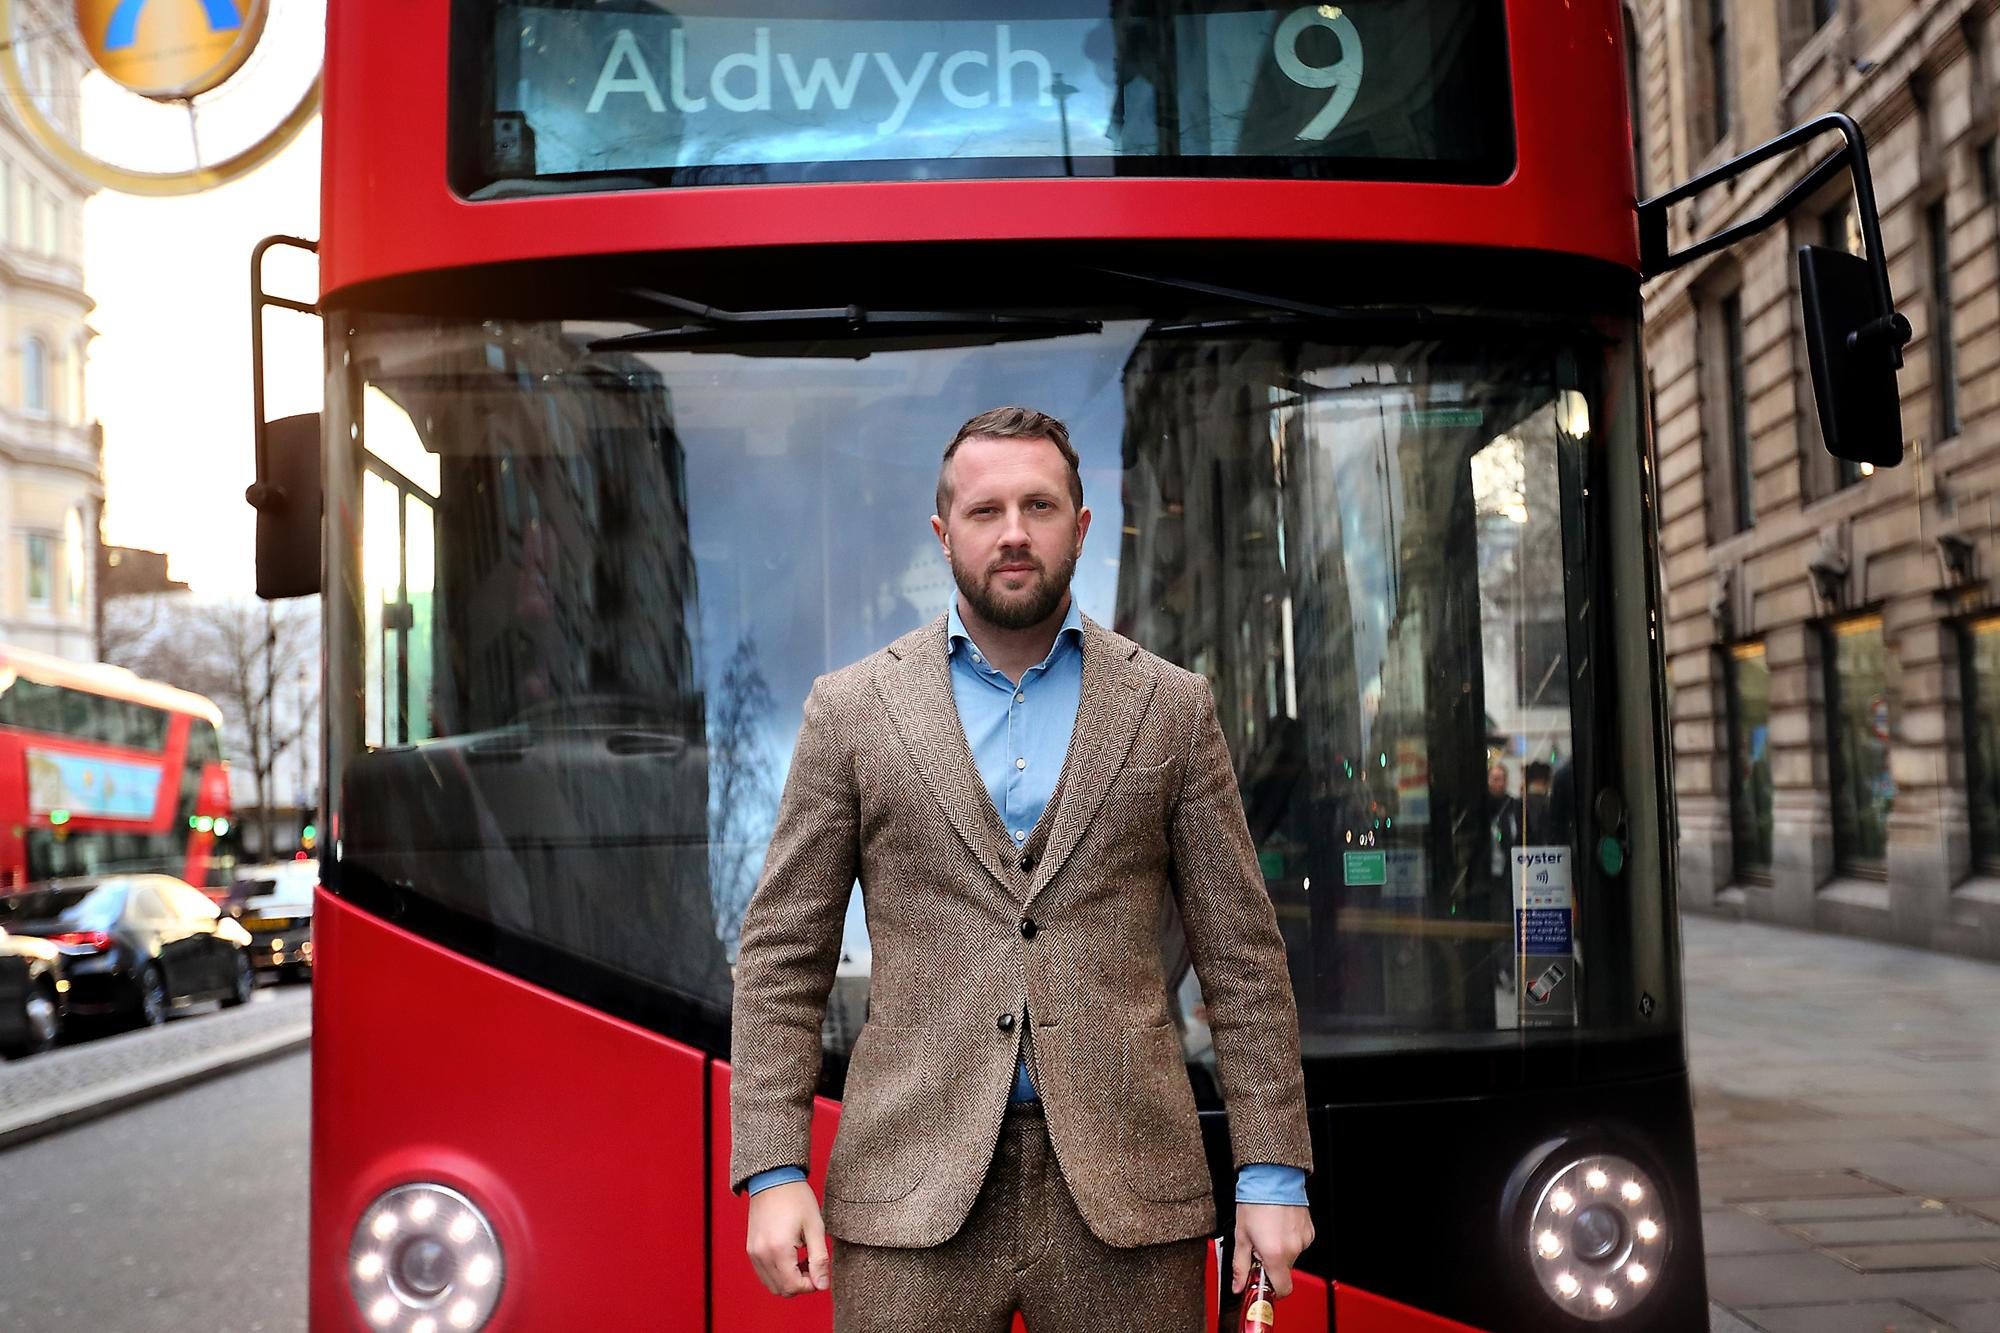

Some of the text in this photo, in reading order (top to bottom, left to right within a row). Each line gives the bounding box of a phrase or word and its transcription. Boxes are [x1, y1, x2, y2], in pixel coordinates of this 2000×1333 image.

[585, 24, 1054, 136] Aldwych
[1273, 5, 1364, 141] 9
[1517, 852, 1562, 868] oyster
